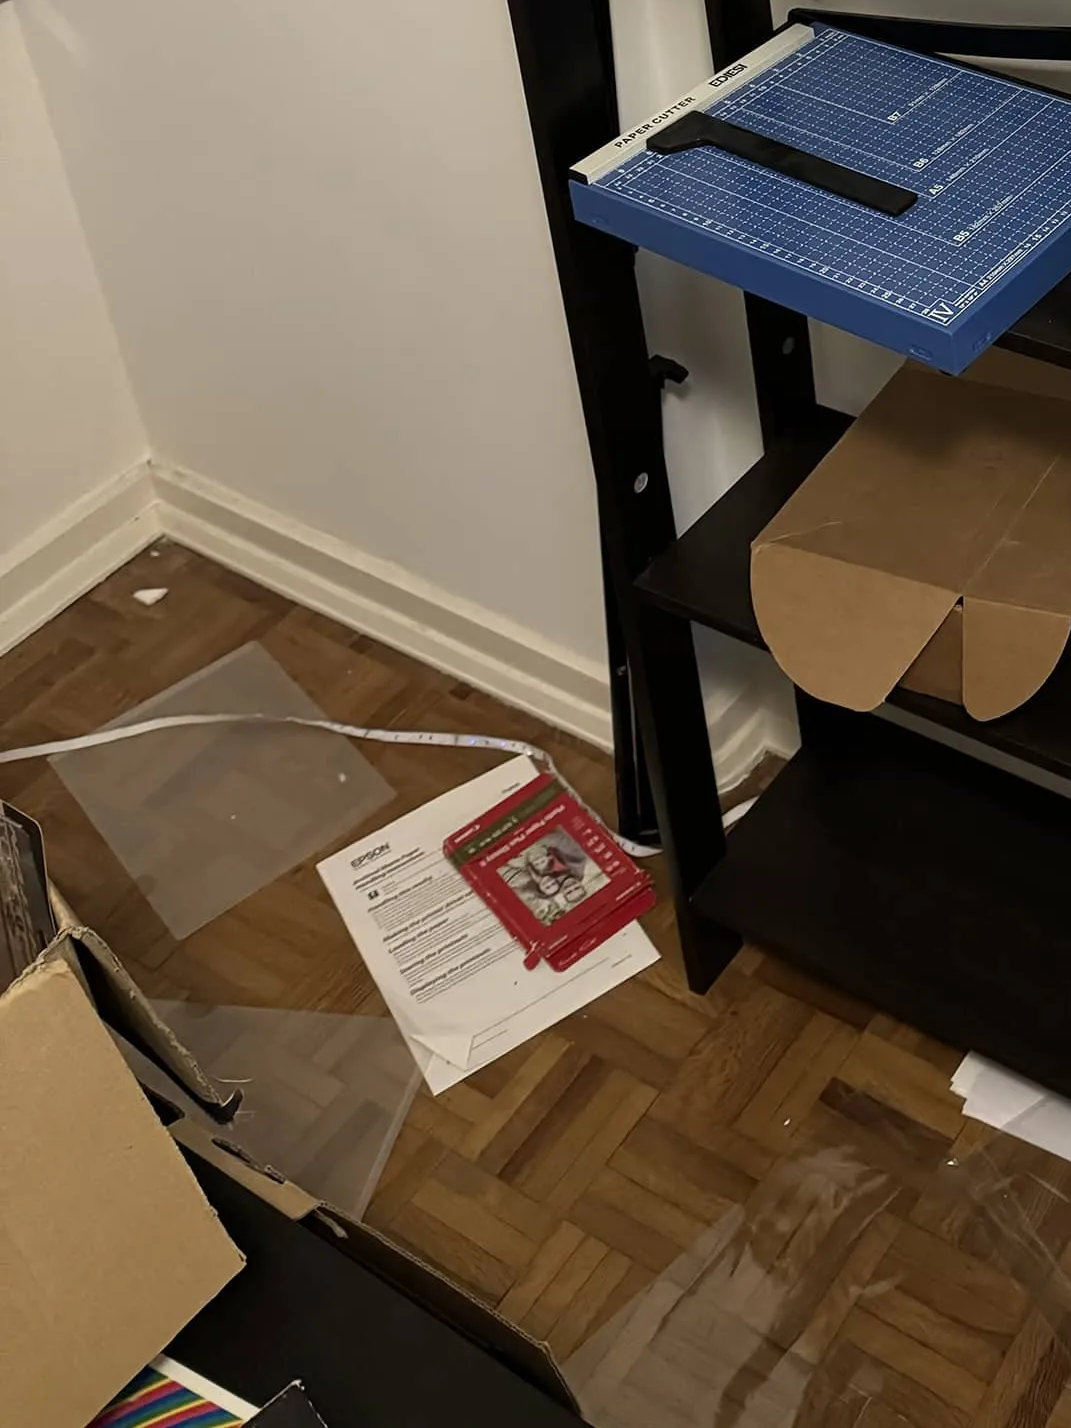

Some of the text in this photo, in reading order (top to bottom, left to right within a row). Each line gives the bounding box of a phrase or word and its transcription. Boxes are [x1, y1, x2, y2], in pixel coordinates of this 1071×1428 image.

[614, 124, 653, 148] PAPER
[652, 97, 696, 124] CUTTER
[928, 183, 943, 194] A5
[350, 842, 390, 868] EPSON
